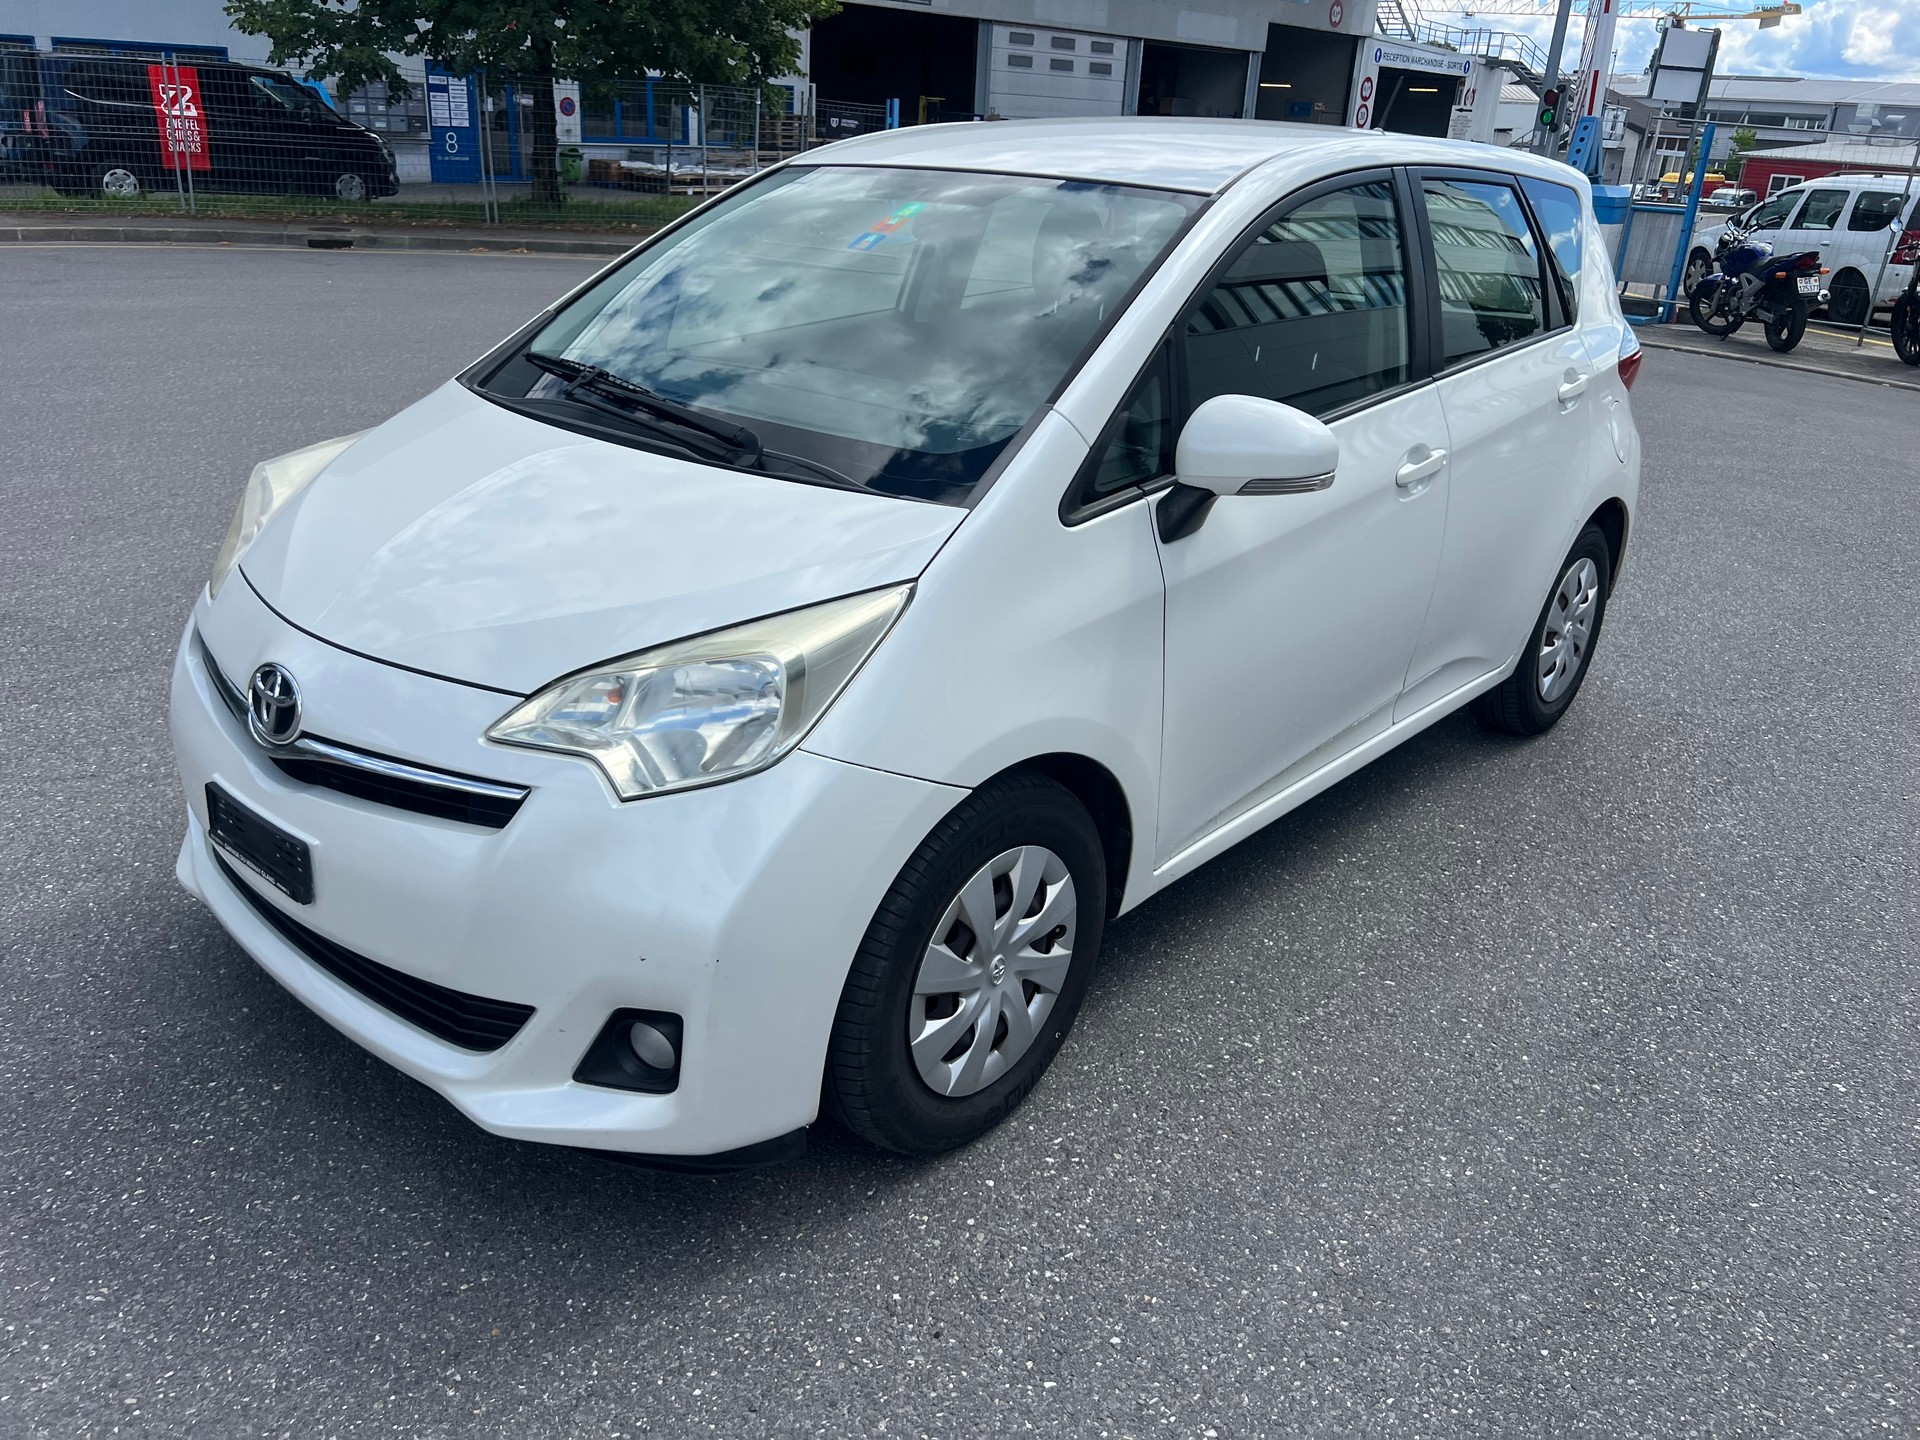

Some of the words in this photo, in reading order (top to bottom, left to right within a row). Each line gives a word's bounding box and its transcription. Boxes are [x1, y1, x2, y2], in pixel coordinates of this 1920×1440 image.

[1383, 52, 1410, 63] RECEPTION
[1447, 61, 1464, 71] SORTIE
[446, 132, 458, 153] 8
